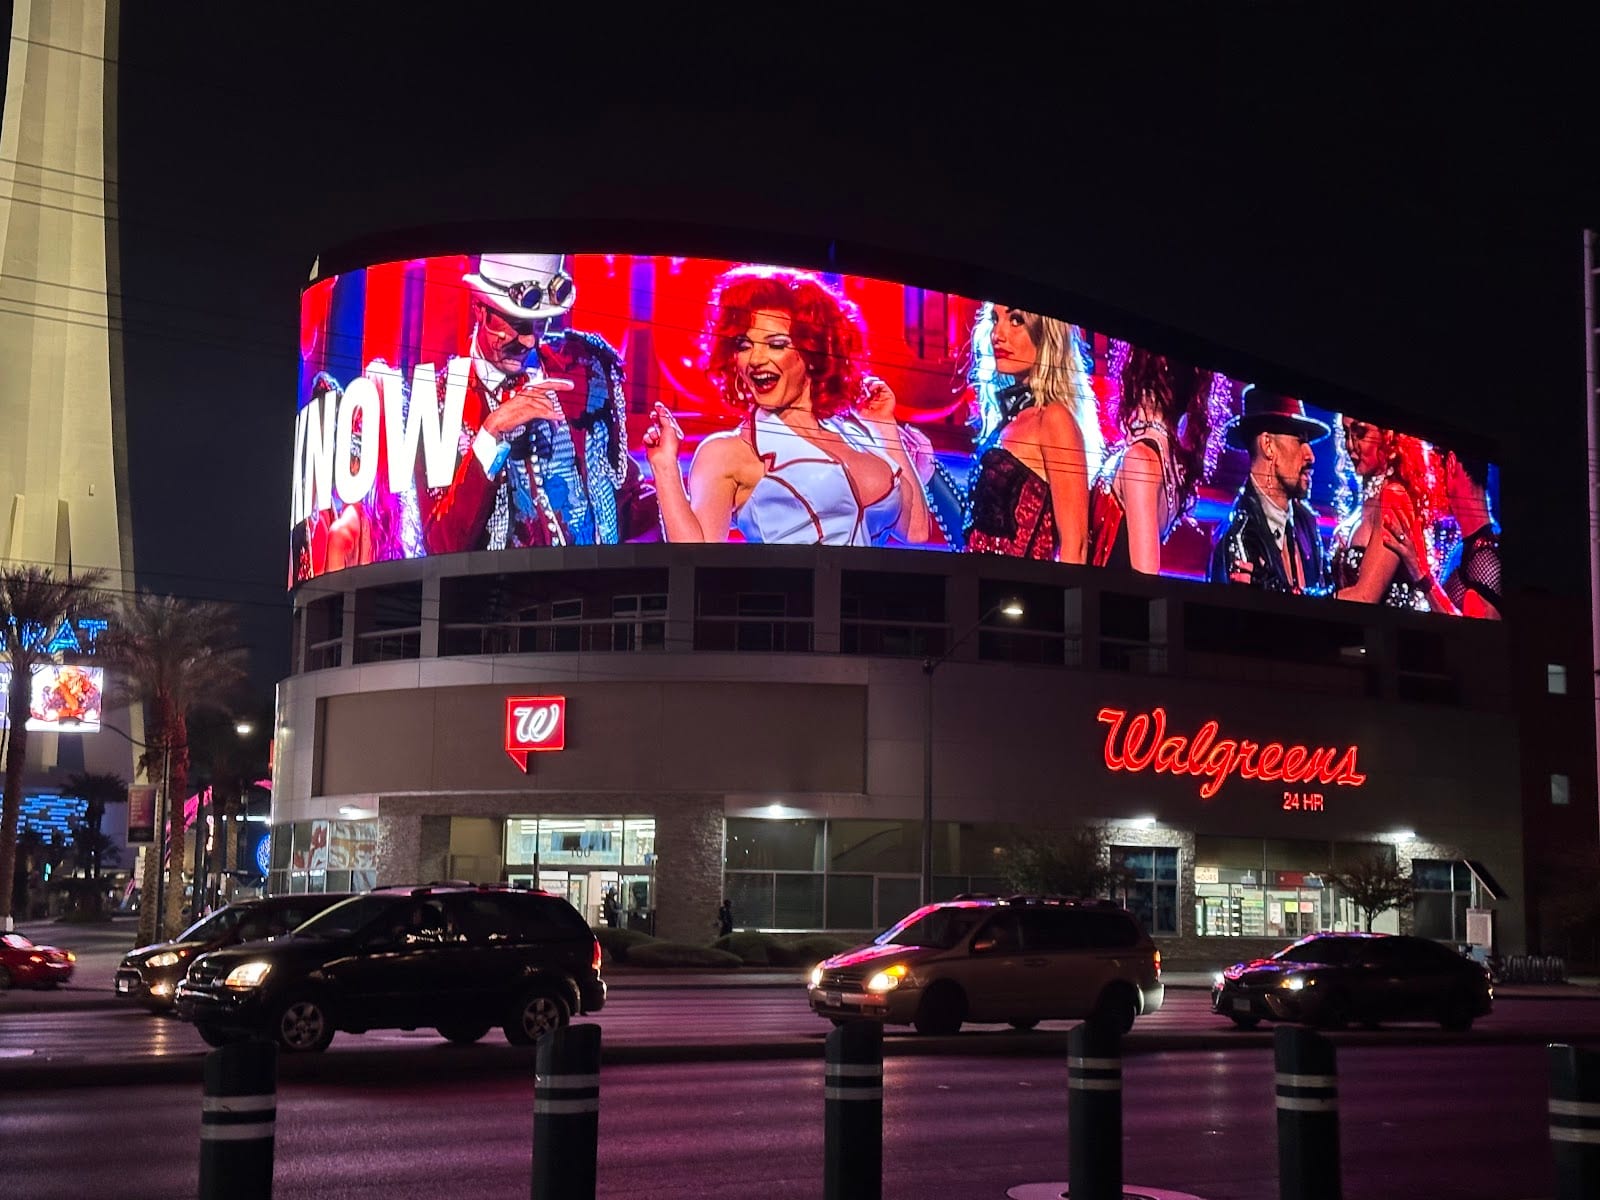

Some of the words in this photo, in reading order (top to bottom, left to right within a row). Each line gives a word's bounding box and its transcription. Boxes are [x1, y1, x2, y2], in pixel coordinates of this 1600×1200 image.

[513, 703, 560, 743] W
[1097, 707, 1367, 799] Walgreens
[1283, 791, 1300, 810] 24
[1303, 793, 1324, 811] HR
